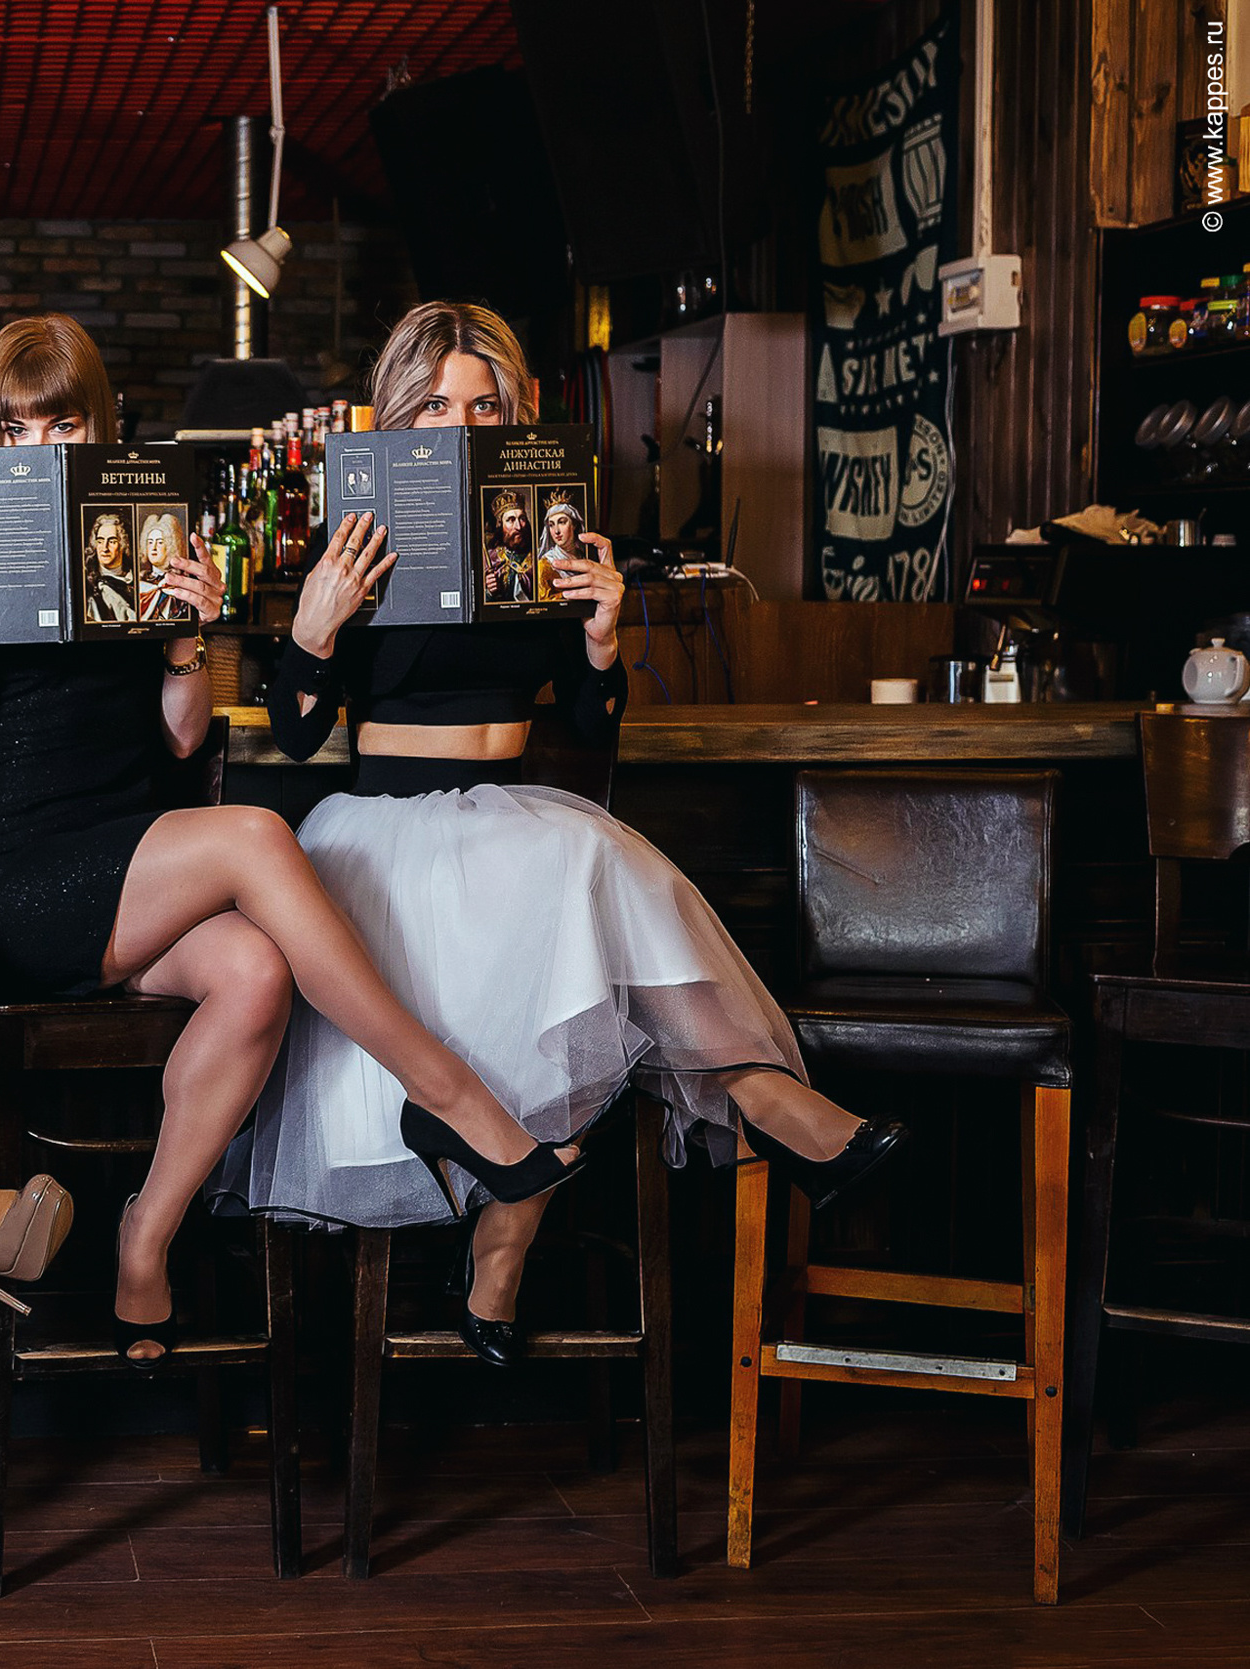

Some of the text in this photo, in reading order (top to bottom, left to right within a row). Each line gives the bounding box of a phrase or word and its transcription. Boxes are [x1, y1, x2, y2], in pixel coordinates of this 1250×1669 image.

[499, 447, 565, 459] АНЖУЙСКАЯ
[503, 460, 562, 472] ДИНАСТИЯ
[101, 473, 166, 484] ВЕТТИНЫ
